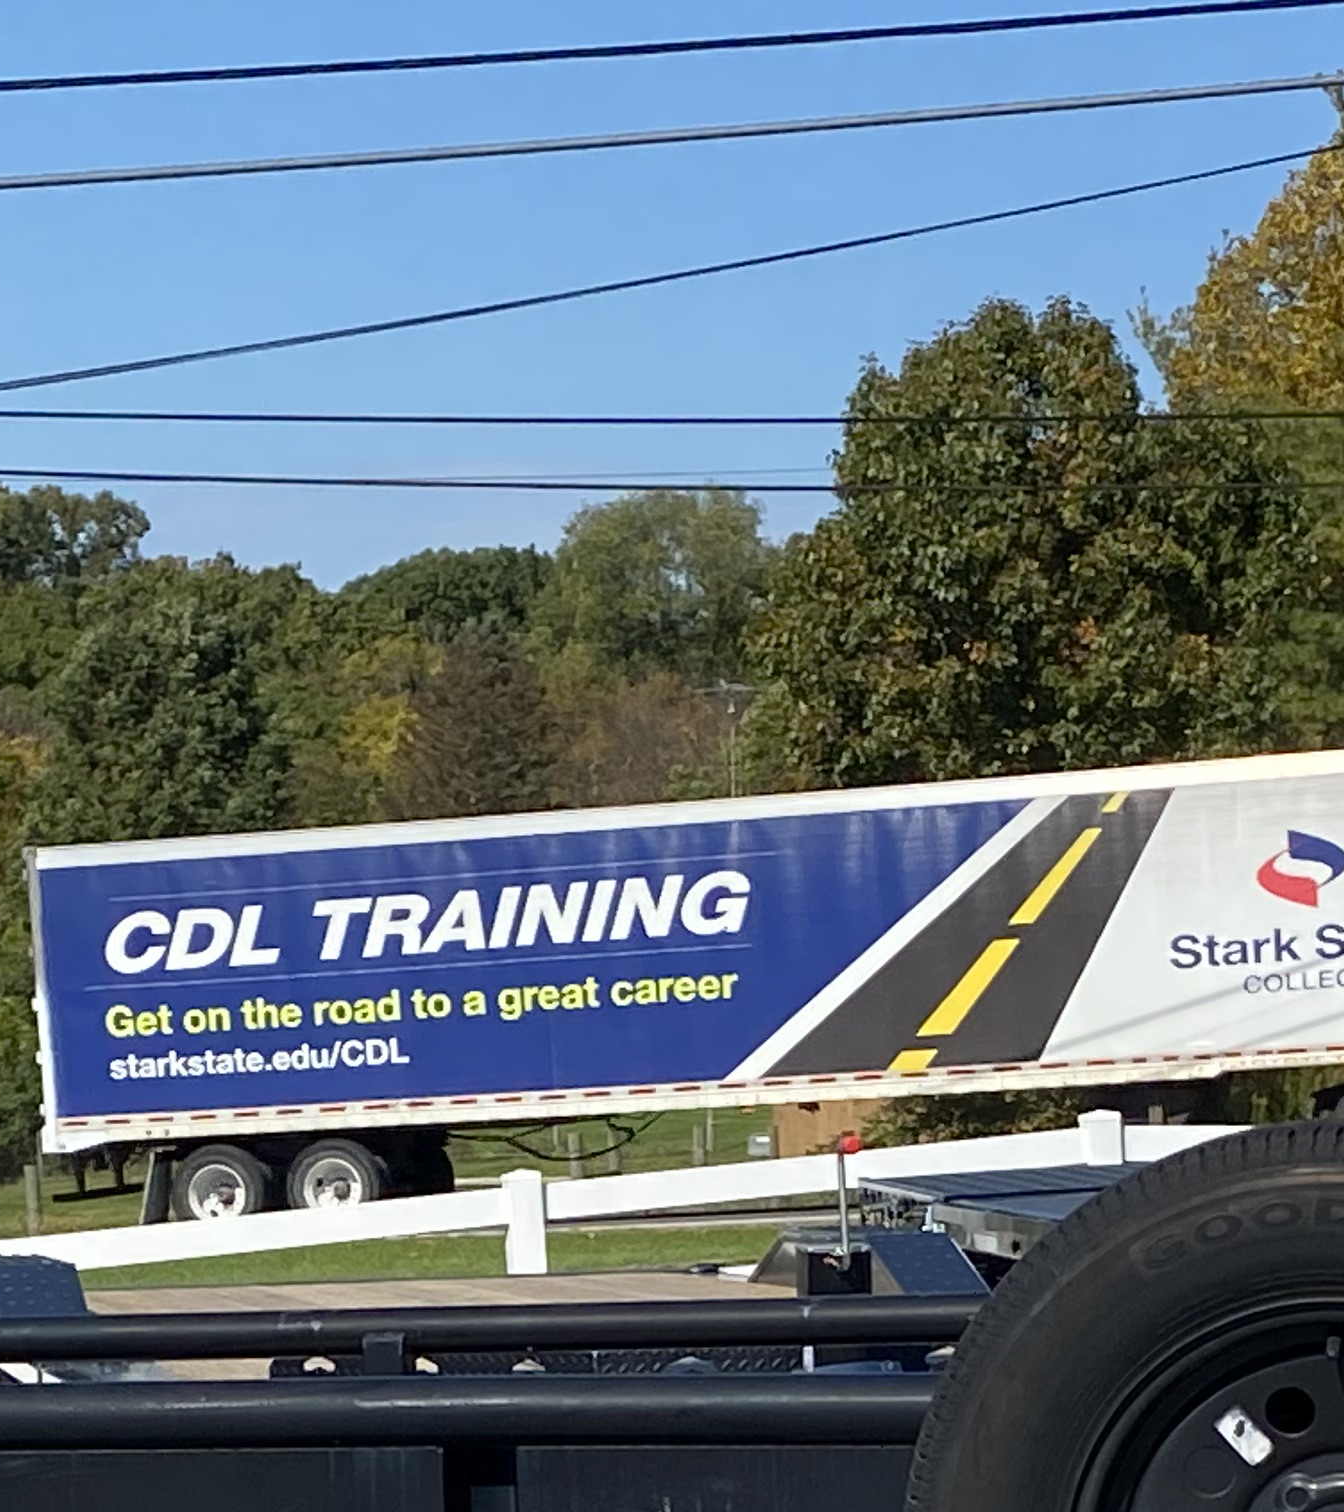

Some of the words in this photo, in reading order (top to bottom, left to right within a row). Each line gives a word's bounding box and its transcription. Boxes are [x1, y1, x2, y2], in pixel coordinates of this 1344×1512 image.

[105, 905, 280, 975] CDL
[313, 870, 752, 960] TRAINING
[1170, 928, 1301, 969] Stark
[105, 1004, 173, 1039] Get
[183, 1008, 232, 1034] on
[240, 997, 302, 1030] the
[314, 989, 402, 1026] road
[411, 989, 452, 1019] to
[463, 991, 487, 1017] a
[498, 976, 601, 1021] great
[611, 972, 739, 1007] career
[110, 1037, 410, 1080] starkstate.edu/CDL
